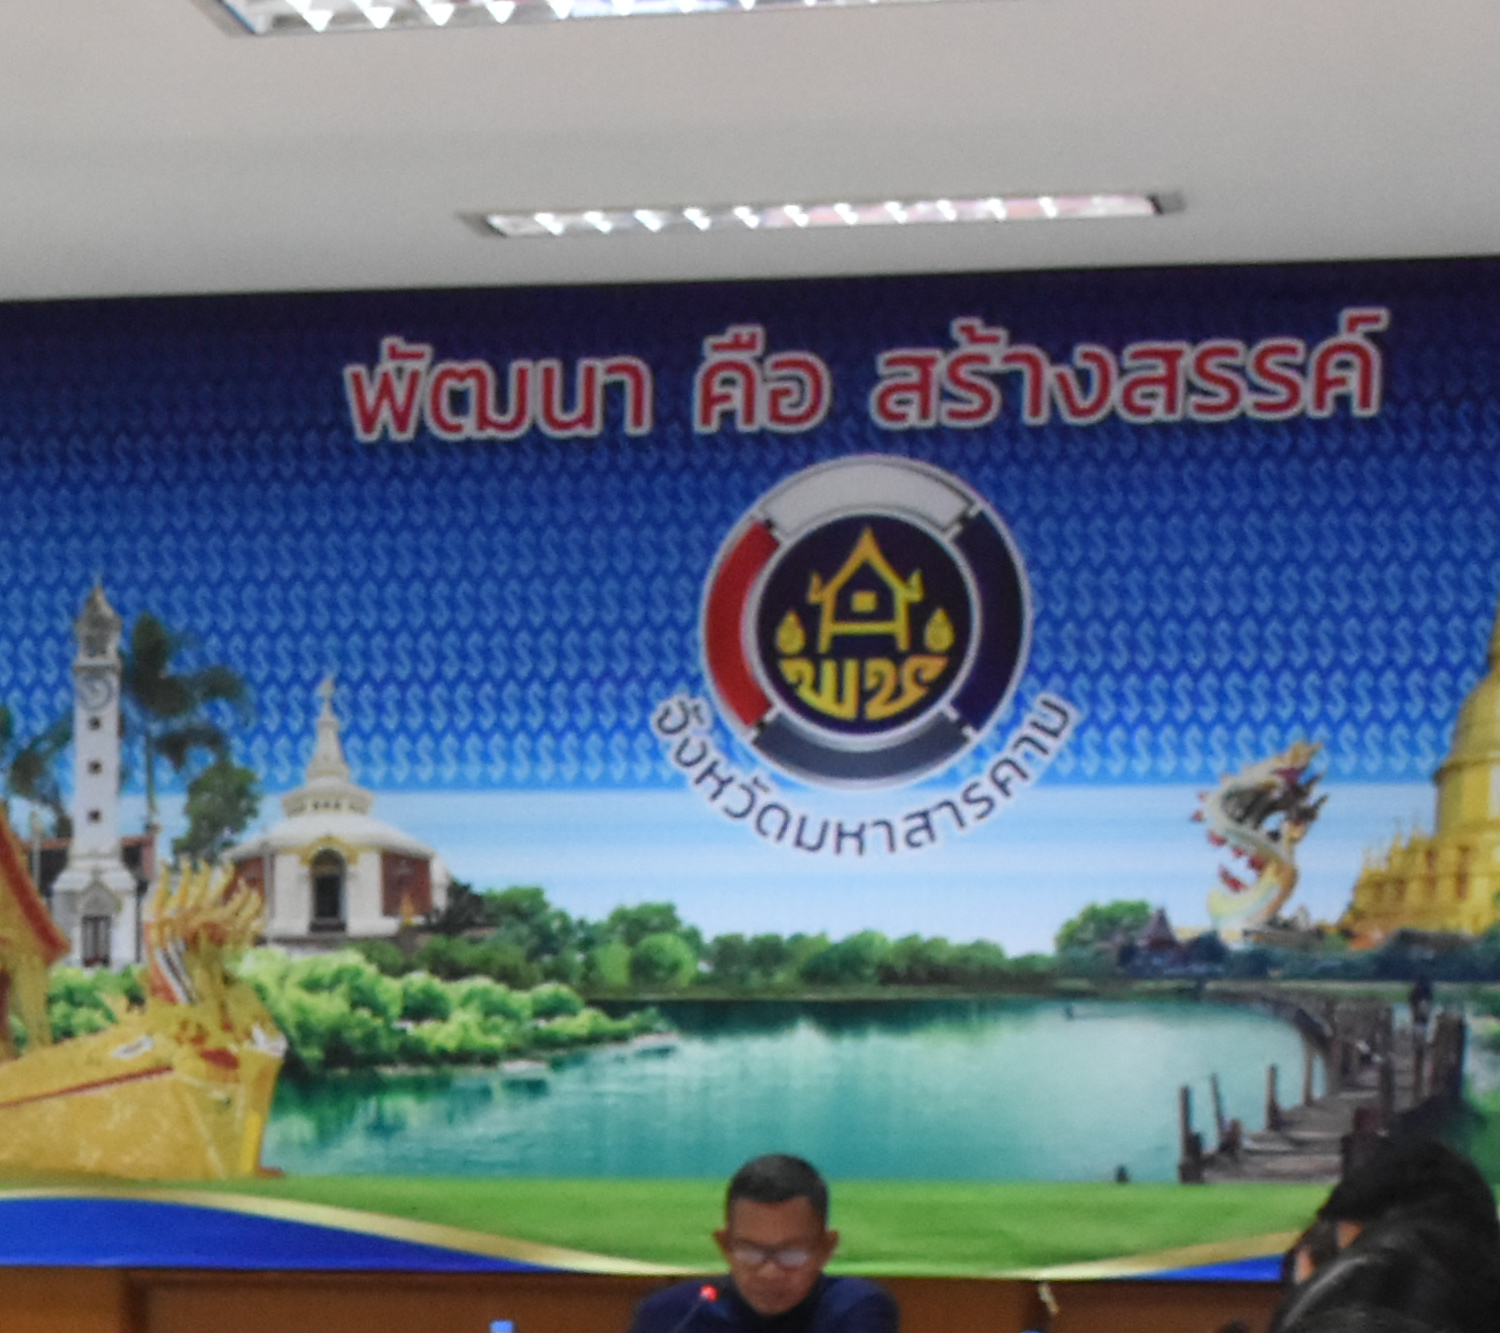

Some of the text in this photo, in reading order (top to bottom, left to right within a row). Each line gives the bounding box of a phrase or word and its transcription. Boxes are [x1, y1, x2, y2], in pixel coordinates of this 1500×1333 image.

[344, 308, 1390, 442] พัฒนา คือ สร้างสรรค์
[652, 691, 1078, 857] จังหวัดมหาสารคาม
